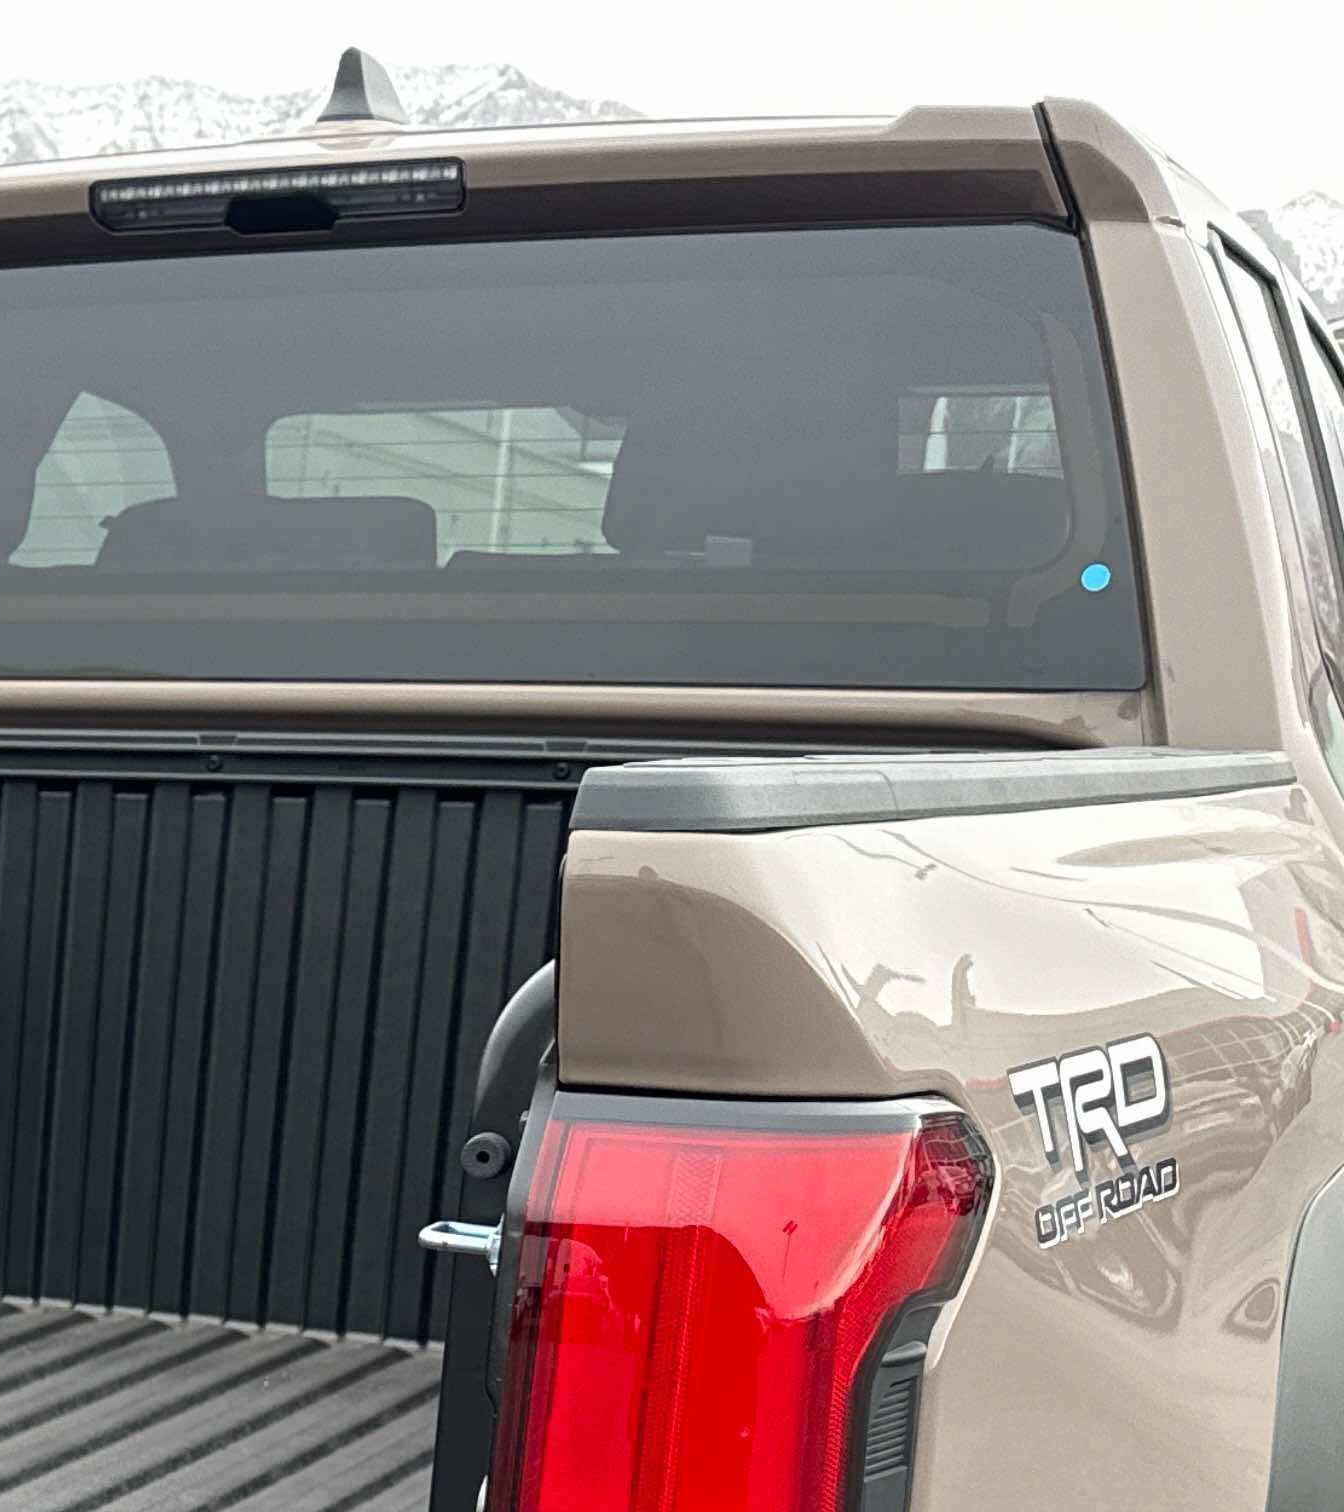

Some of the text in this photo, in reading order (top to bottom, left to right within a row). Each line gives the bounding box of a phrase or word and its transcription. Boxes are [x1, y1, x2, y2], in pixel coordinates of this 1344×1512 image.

[1007, 1032, 1173, 1187] TRD
[1035, 1158, 1180, 1249] OFF ROAD
